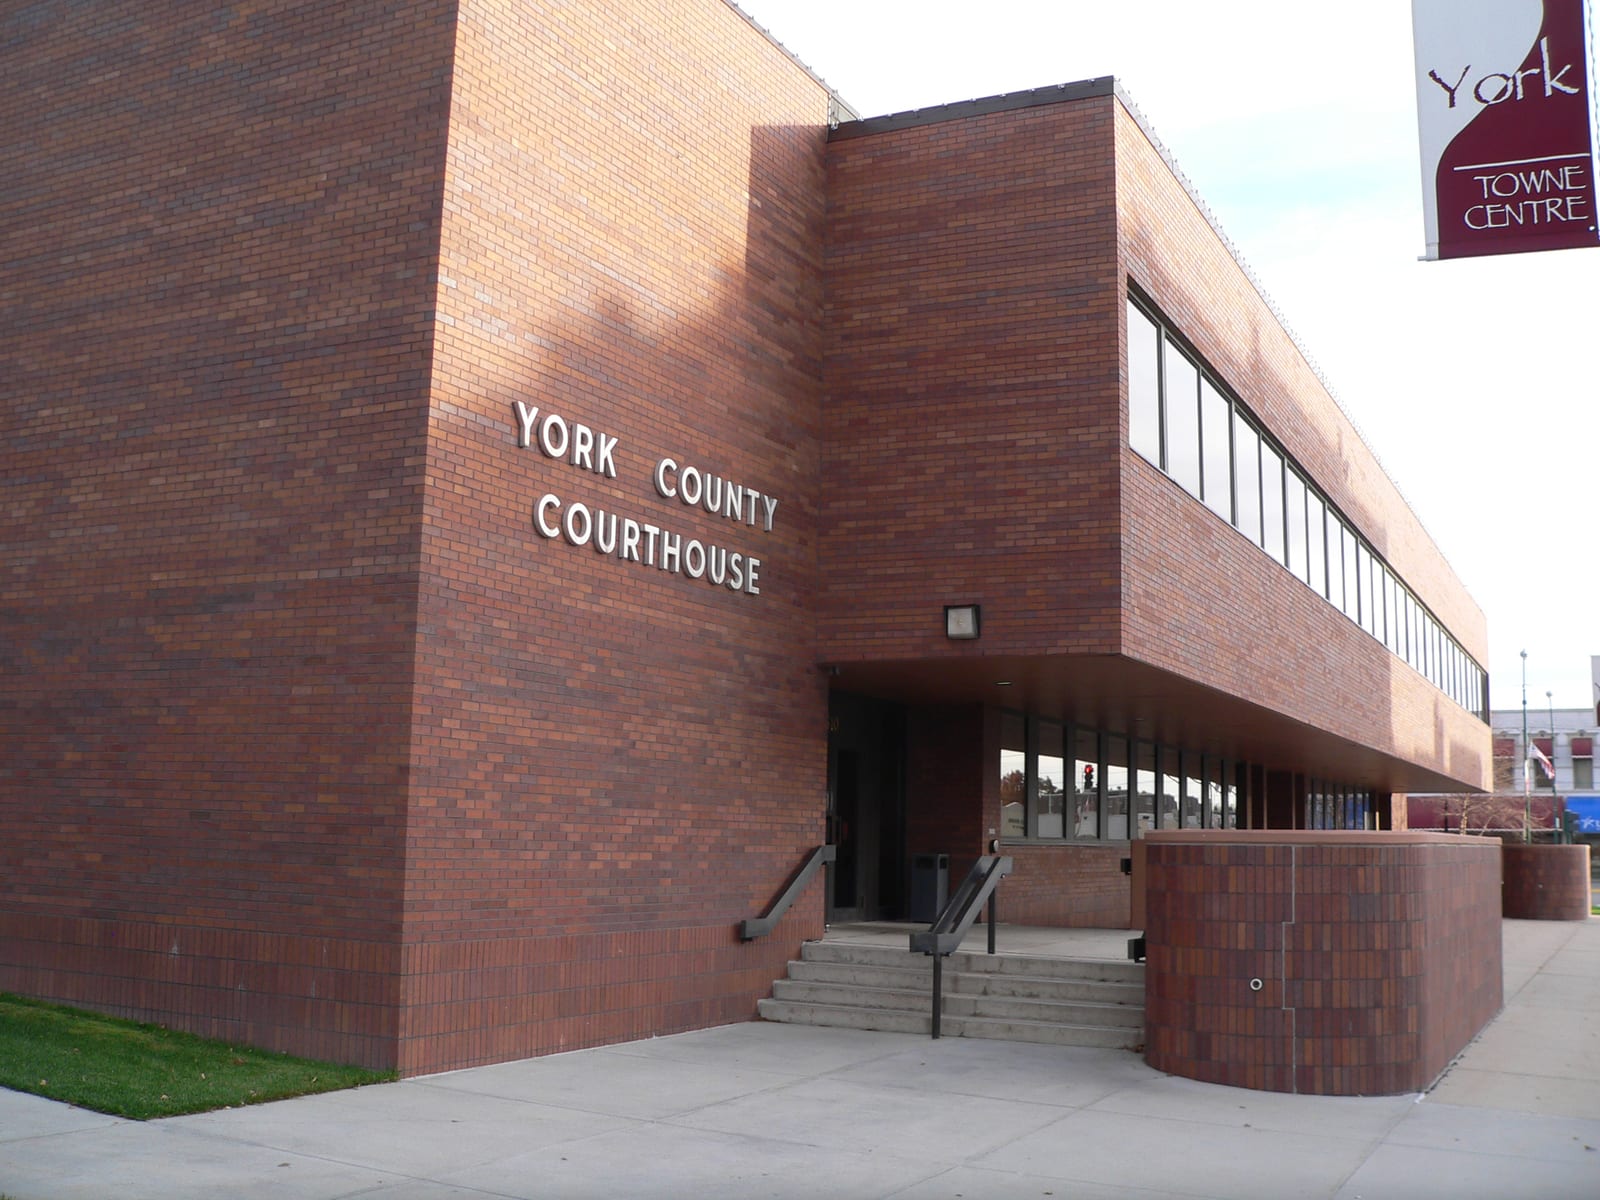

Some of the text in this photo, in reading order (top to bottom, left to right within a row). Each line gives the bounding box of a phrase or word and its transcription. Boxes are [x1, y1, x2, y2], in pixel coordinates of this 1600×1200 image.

[1428, 37, 1579, 108] York
[1473, 166, 1586, 199] TOWNE
[512, 400, 778, 532] YORK COUNTY
[533, 494, 761, 595] COURTHOUSE
